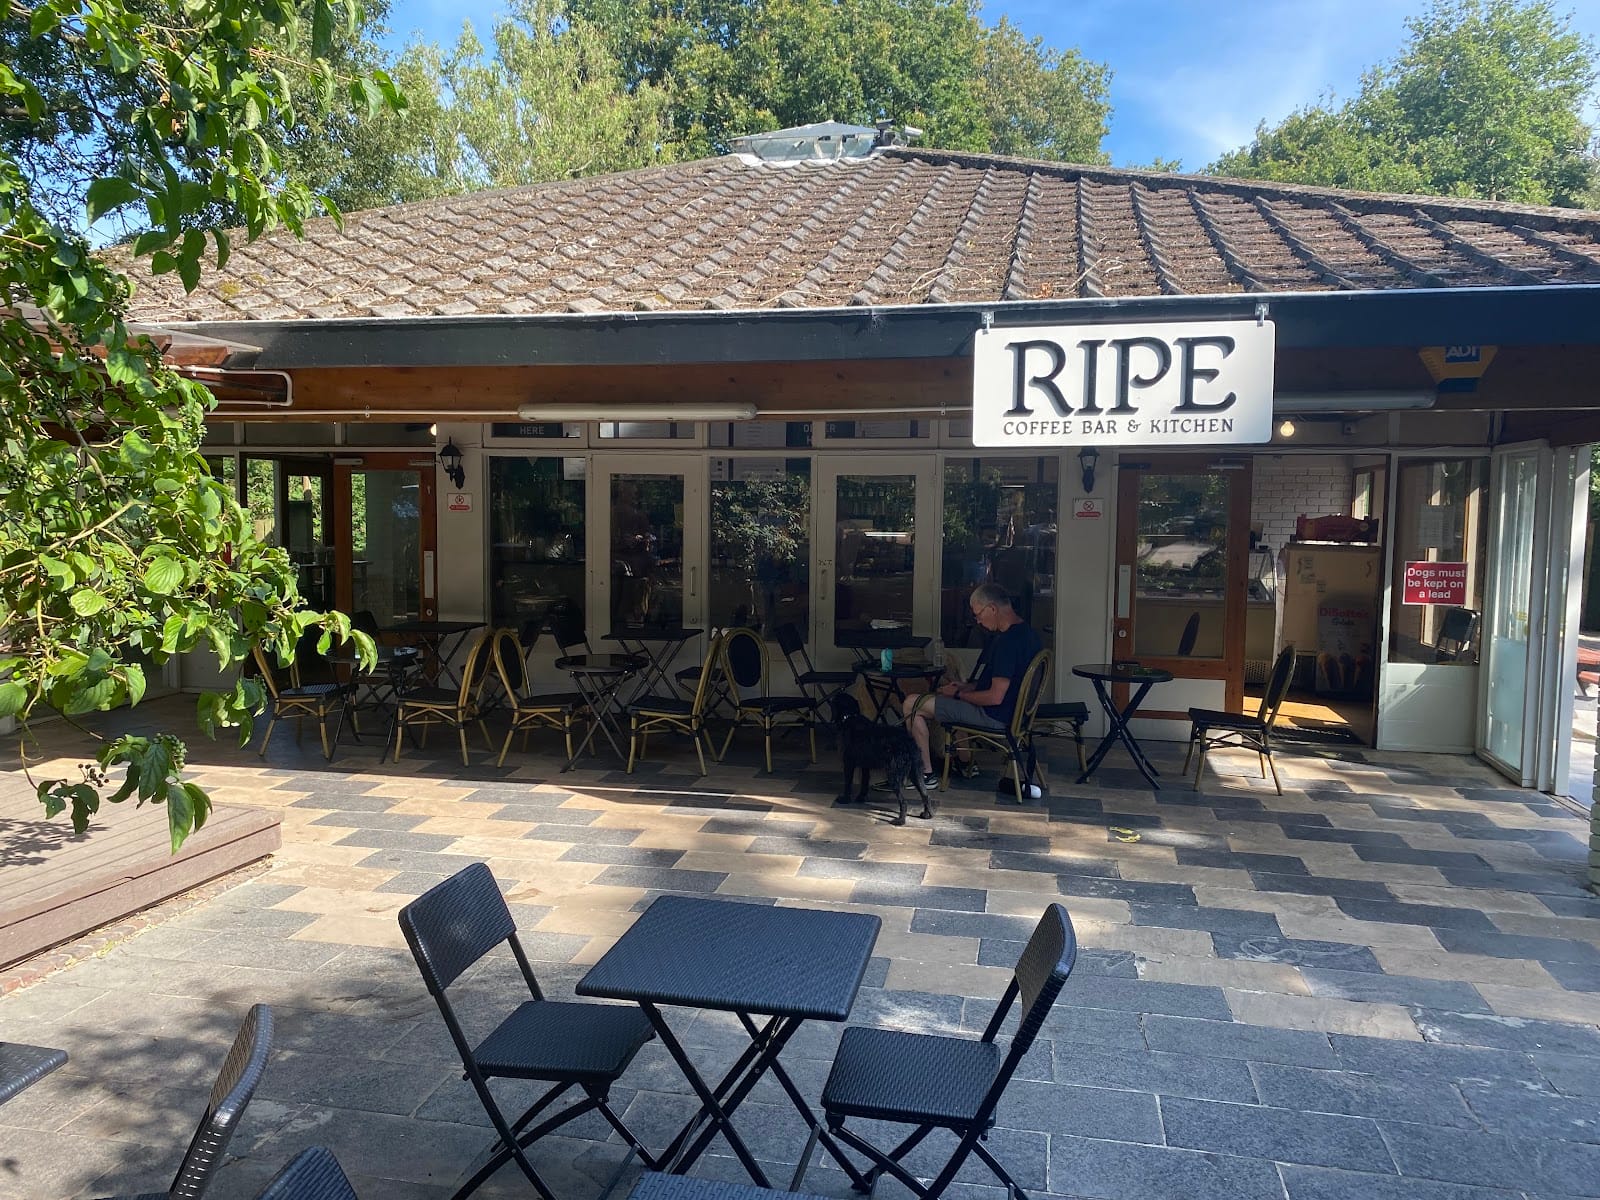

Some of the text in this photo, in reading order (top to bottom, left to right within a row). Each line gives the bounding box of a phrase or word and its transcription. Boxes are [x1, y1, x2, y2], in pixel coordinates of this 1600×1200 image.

[1002, 335, 1237, 418] RIPE
[519, 425, 545, 436] HERE
[1002, 418, 1234, 436] COFFEE BAR & KITCHEN
[1407, 567, 1465, 579] Dogs must
[1407, 578, 1464, 590] be kept on
[1418, 589, 1451, 599] a lead
